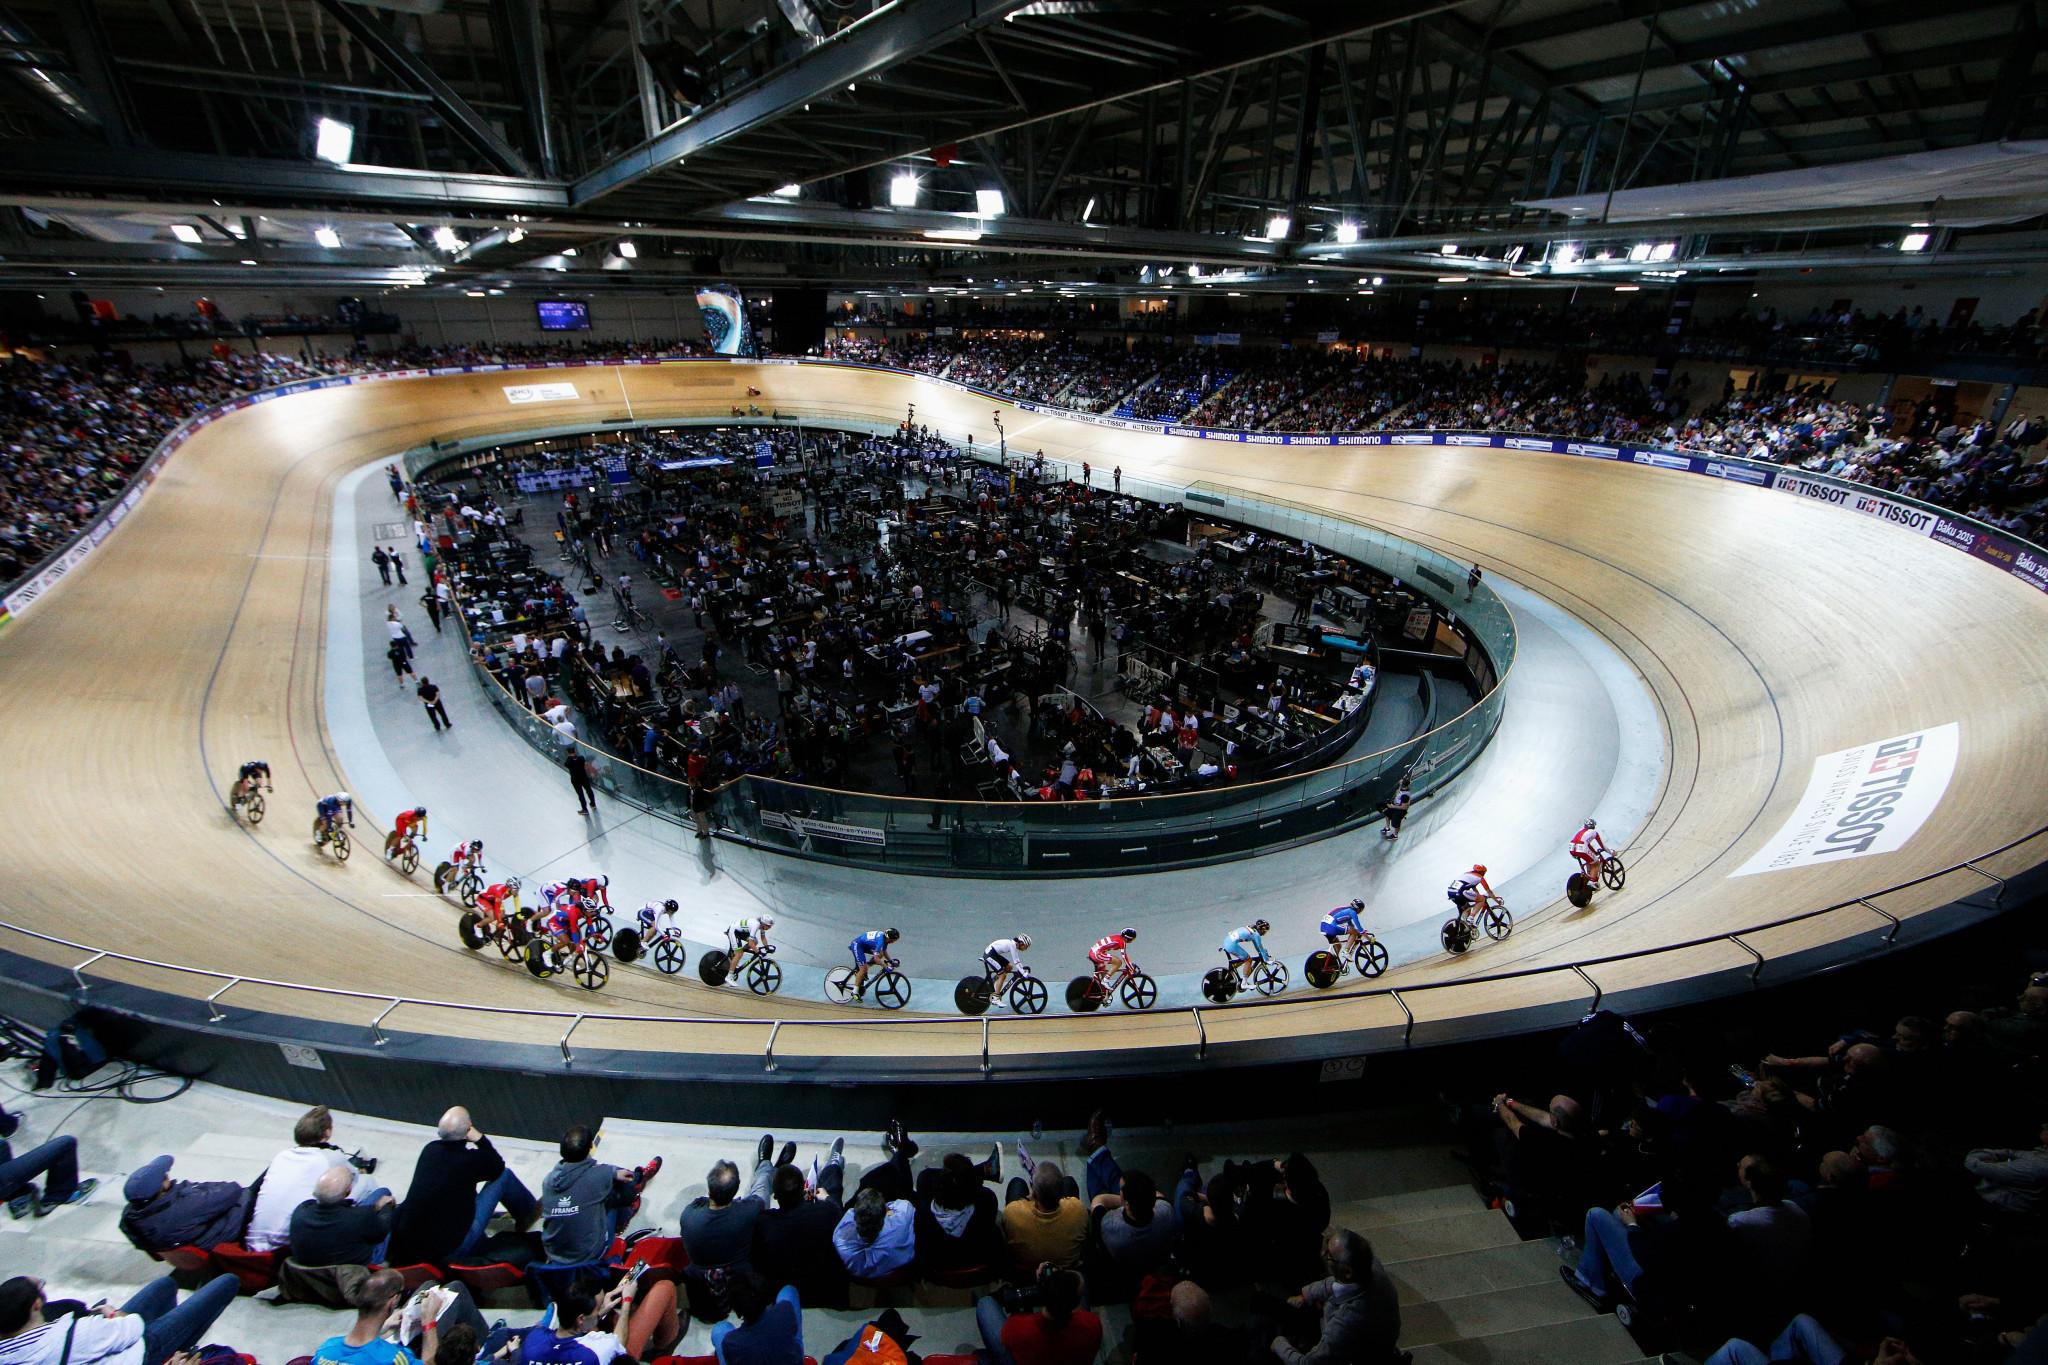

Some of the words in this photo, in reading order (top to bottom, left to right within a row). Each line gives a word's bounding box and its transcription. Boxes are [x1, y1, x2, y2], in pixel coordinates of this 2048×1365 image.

[1050, 409, 1067, 418] TISSOT
[1076, 414, 1096, 423] TISSOT
[1106, 419, 1127, 428] TISSOT
[1141, 424, 1162, 433] TISSOT
[1169, 427, 1200, 438] SHIMANO
[1206, 431, 1240, 441] SHIMANO
[1246, 434, 1283, 444] SHIMANO
[1290, 436, 1331, 445] SHIMANO
[1338, 436, 1381, 445] SHIMANO
[1798, 481, 1850, 505] TISSOT
[1877, 501, 1932, 531] TISSOT
[1936, 520, 1957, 536] Baku
[1955, 528, 1975, 545] 2015
[2016, 552, 2037, 572] Baku
[1812, 766, 1914, 856] TISSOT
